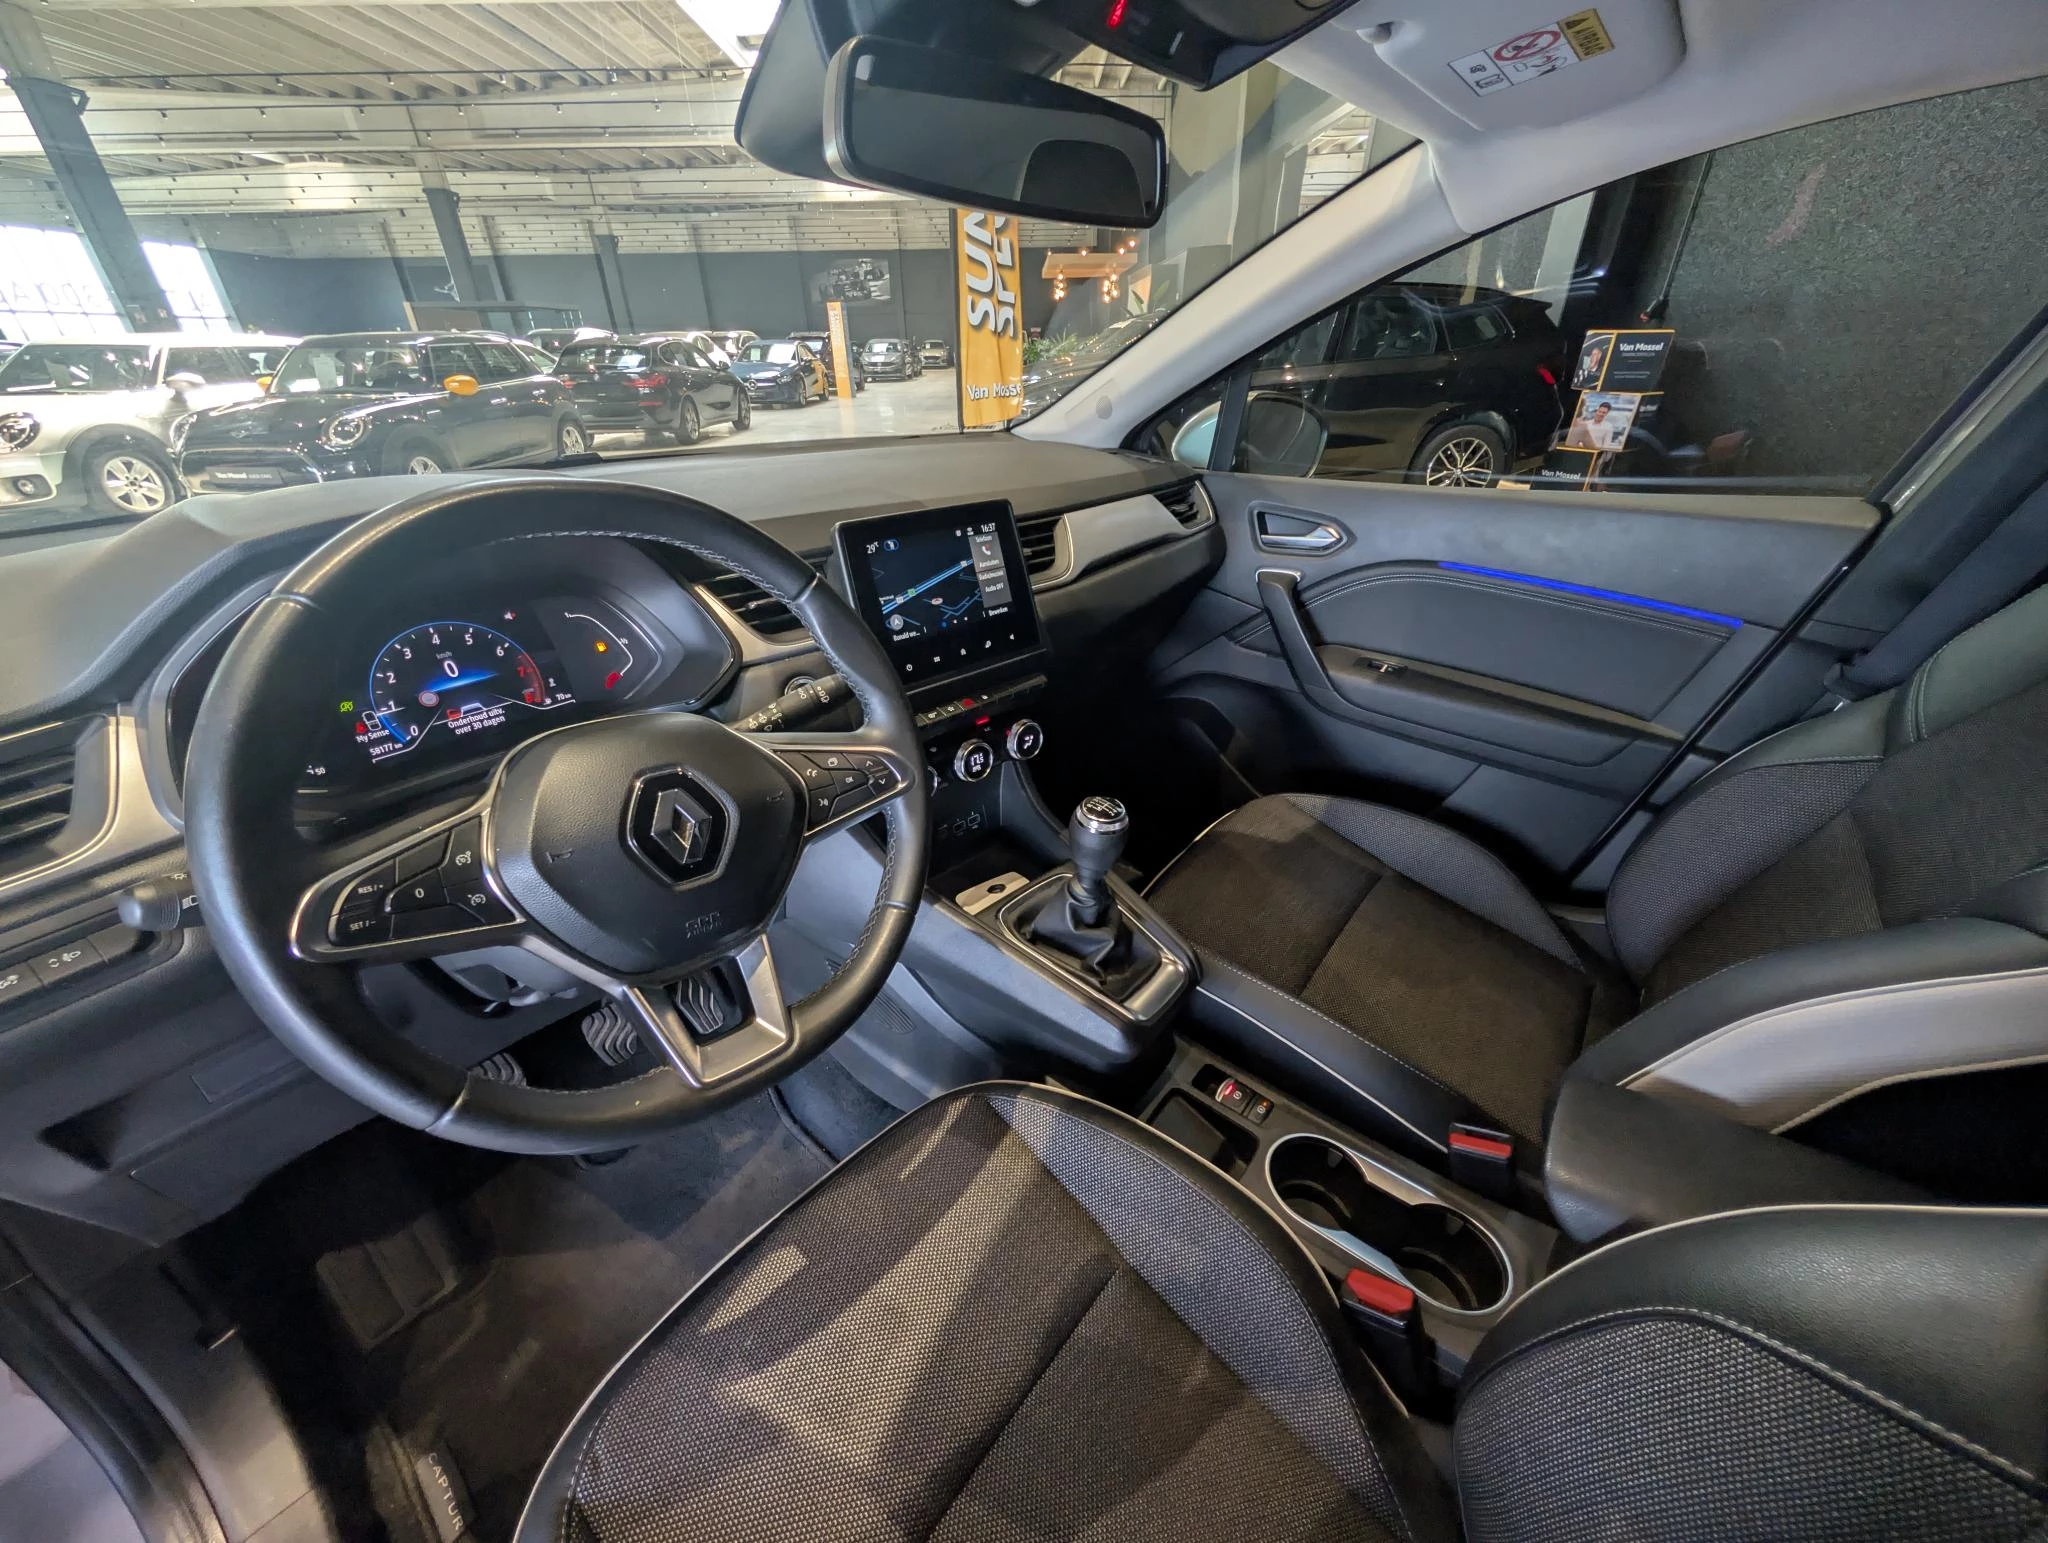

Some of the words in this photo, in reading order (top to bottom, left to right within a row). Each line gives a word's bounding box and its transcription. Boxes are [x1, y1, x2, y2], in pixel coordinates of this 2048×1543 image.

[1619, 343, 1635, 352] Van
[1635, 342, 1664, 352] Mossel
[967, 384, 988, 400] Van
[1542, 469, 1555, 477] Van
[1555, 470, 1581, 480] Mossel
[432, 634, 441, 645] 4
[464, 634, 473, 645] 5
[402, 647, 412, 659] 3
[496, 645, 504, 657] 6
[443, 660, 459, 678] 0
[386, 672, 396, 684] 2
[555, 693, 565, 701] 70
[388, 700, 396, 710] 1
[447, 711, 489, 729] Onderhoud
[488, 708, 506, 717] uitv.
[455, 725, 472, 735] over
[472, 721, 482, 730] 30
[483, 715, 506, 727] dagen
[356, 734, 369, 744] My
[368, 730, 390, 741] Sense
[410, 726, 419, 737] 0
[369, 743, 394, 756] 58177
[314, 767, 326, 776] 50
[428, 1452, 464, 1531] CAPTUR
